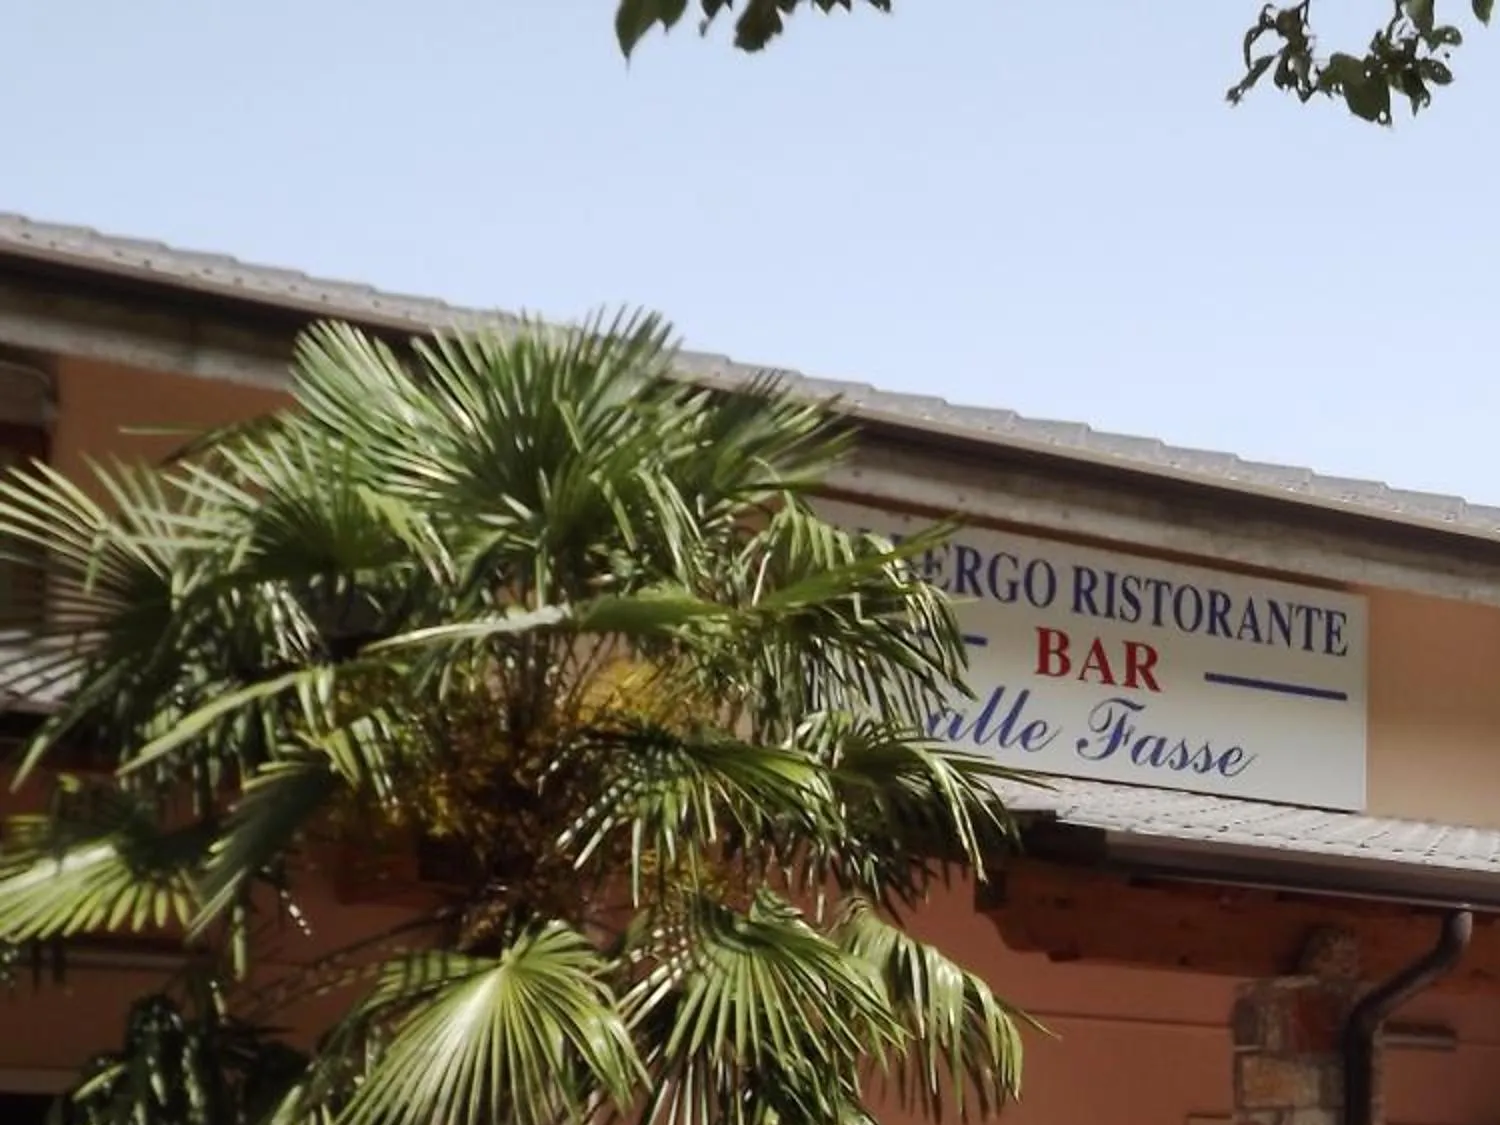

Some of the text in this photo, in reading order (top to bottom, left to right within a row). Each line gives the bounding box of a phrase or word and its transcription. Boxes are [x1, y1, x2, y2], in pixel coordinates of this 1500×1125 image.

[1071, 564, 1349, 657] RISTORANTE
[1034, 626, 1161, 692] BAR
[1076, 697, 1258, 777] Fasse
